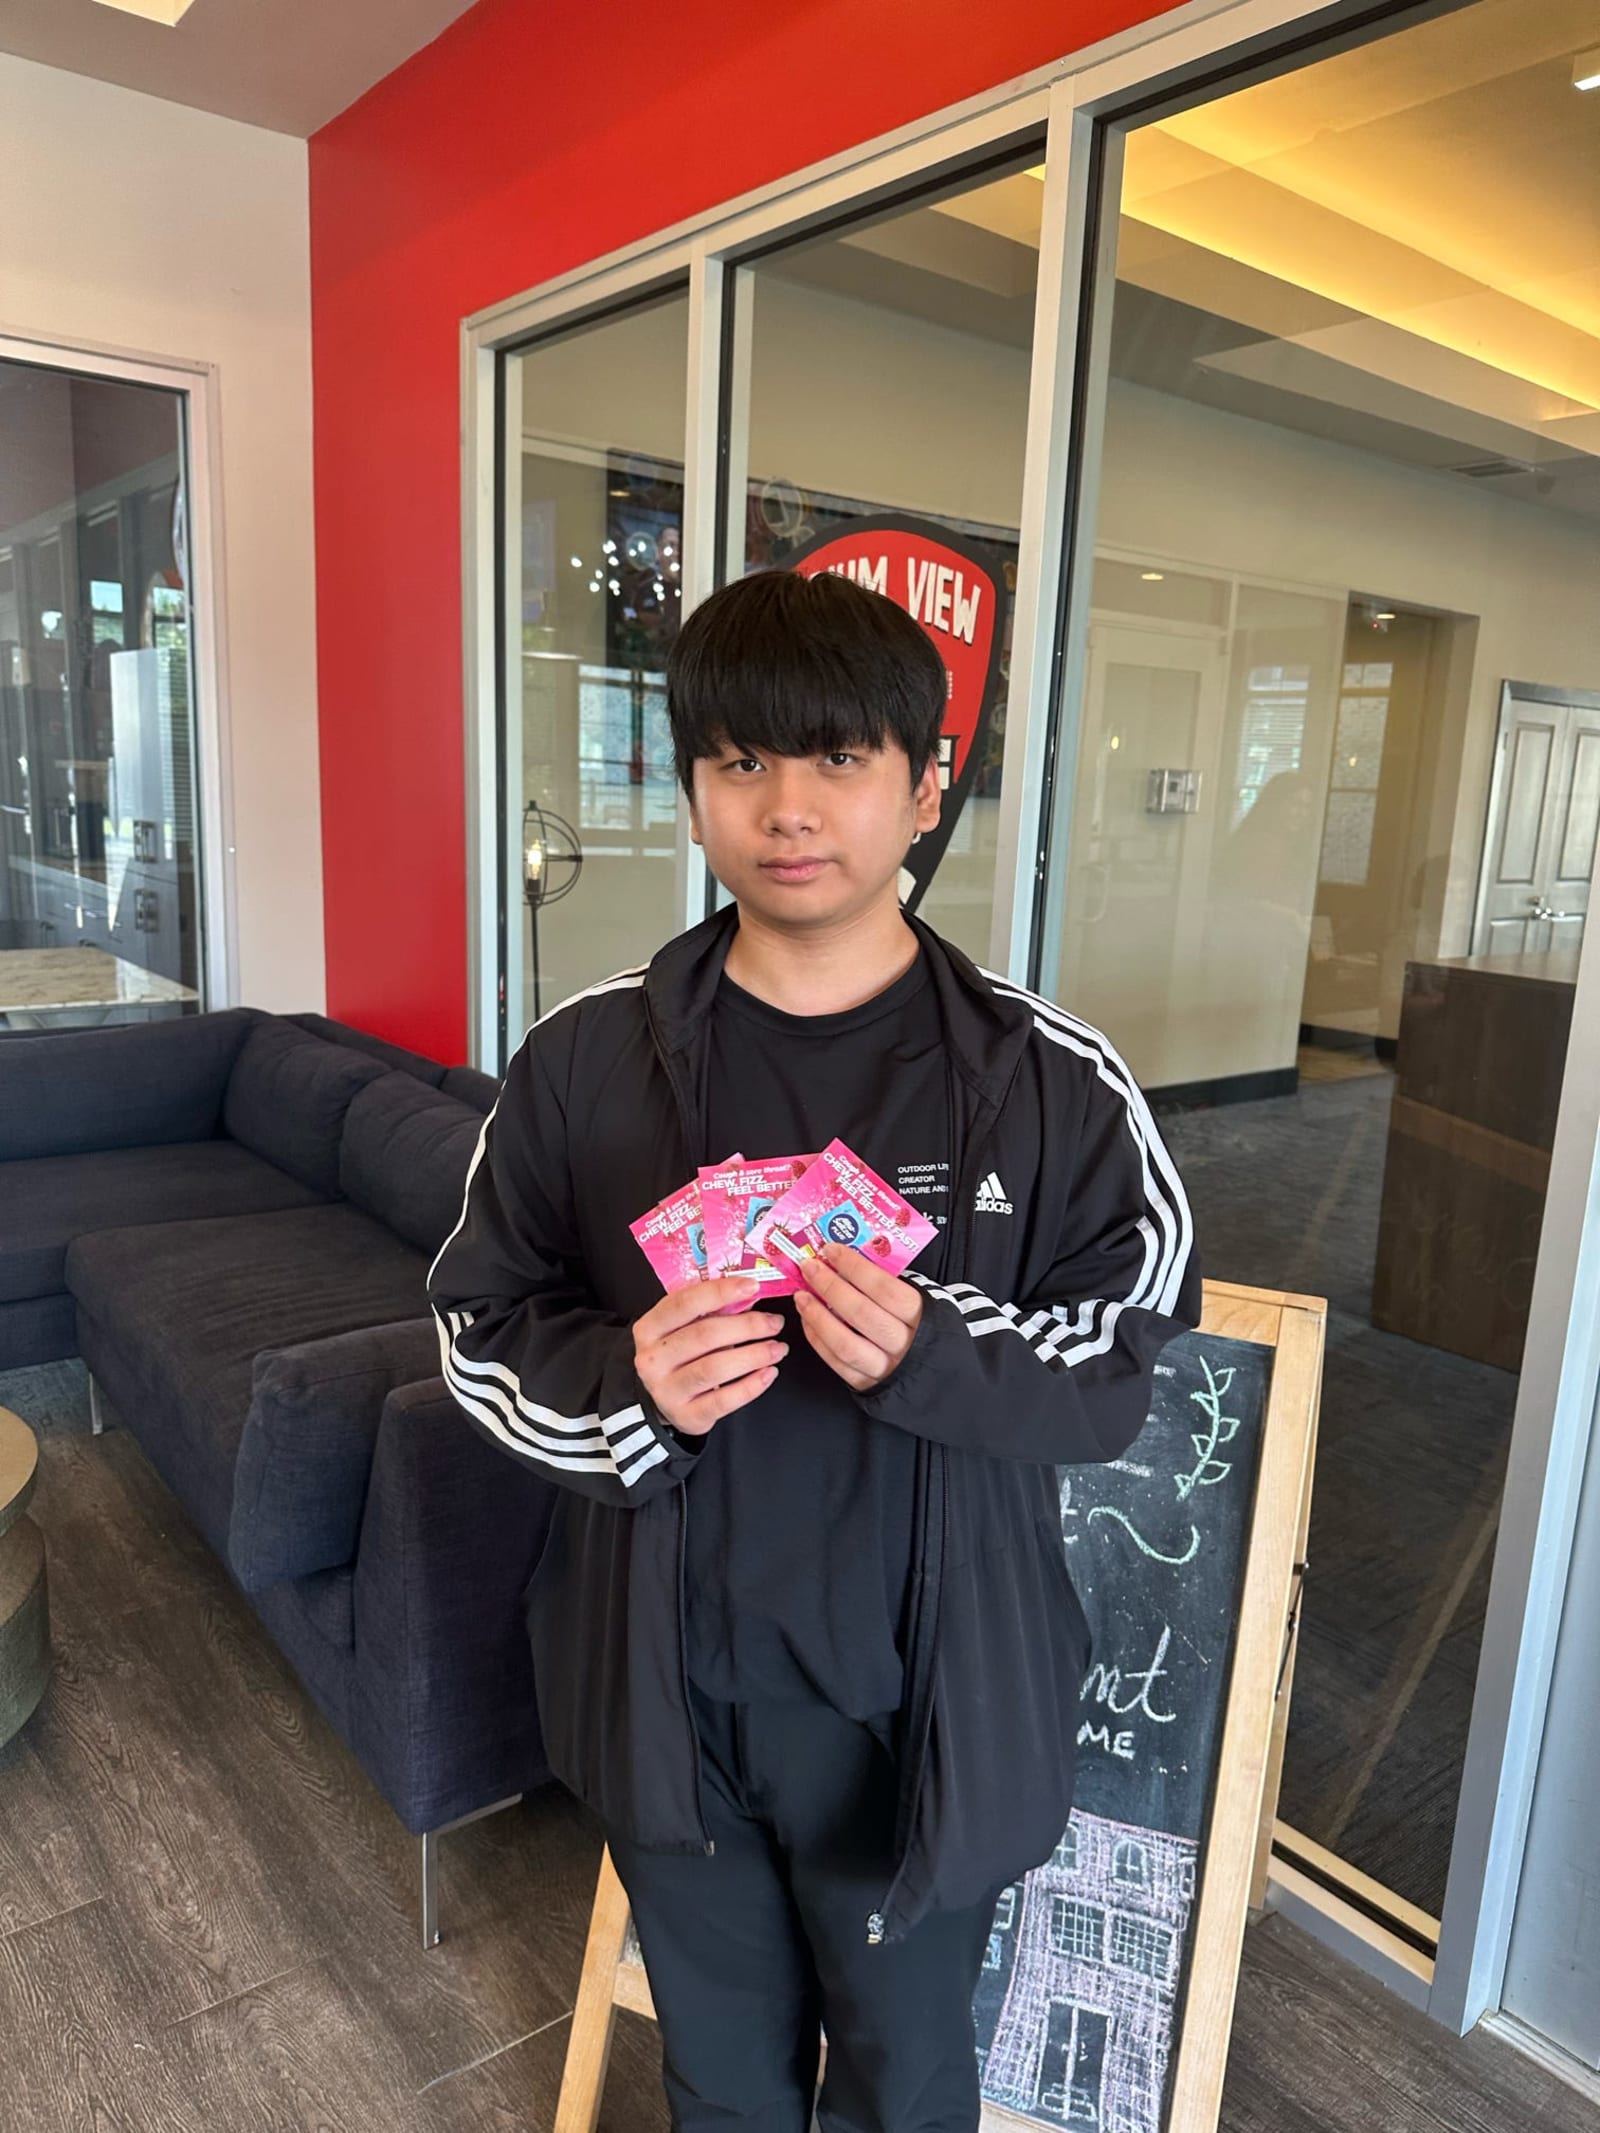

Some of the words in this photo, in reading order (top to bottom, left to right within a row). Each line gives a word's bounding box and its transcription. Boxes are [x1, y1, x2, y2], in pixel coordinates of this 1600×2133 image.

[908, 556, 981, 644] VIEW
[897, 1164, 936, 1174] OUTDOOR
[898, 1175, 935, 1184] CREATOR
[727, 1184, 755, 1197] FEEL
[756, 1181, 796, 1193] BETTE
[899, 1186, 931, 1195] NATURE
[835, 1176, 859, 1200] FEEL
[858, 1196, 896, 1229] BETTER
